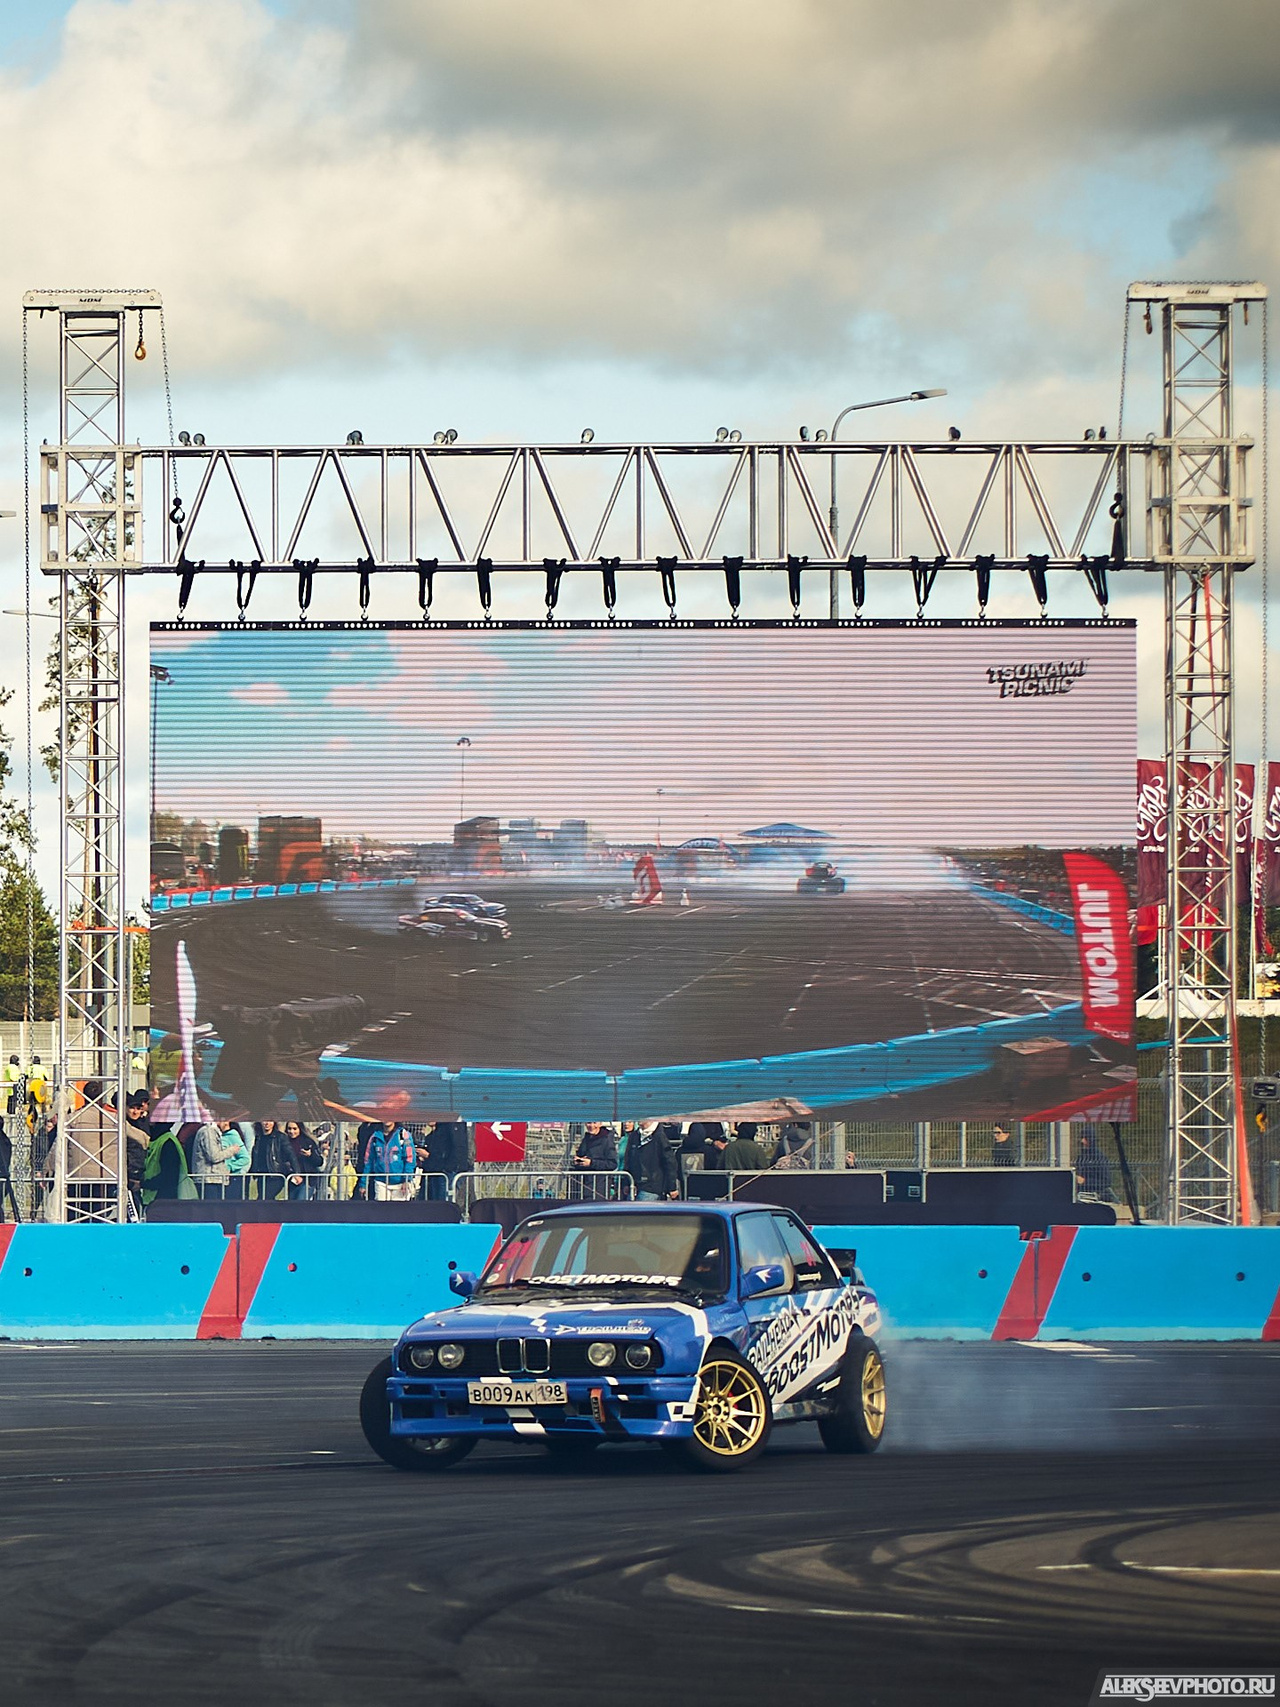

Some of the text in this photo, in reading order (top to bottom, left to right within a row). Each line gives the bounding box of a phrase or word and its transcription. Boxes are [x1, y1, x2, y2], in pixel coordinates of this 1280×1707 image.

[986, 659, 1089, 683] TSUNAMI
[1000, 676, 1075, 698] PICNIC
[521, 1274, 683, 1287] OOSTMOTORS
[473, 1384, 563, 1402] В009АК 198
